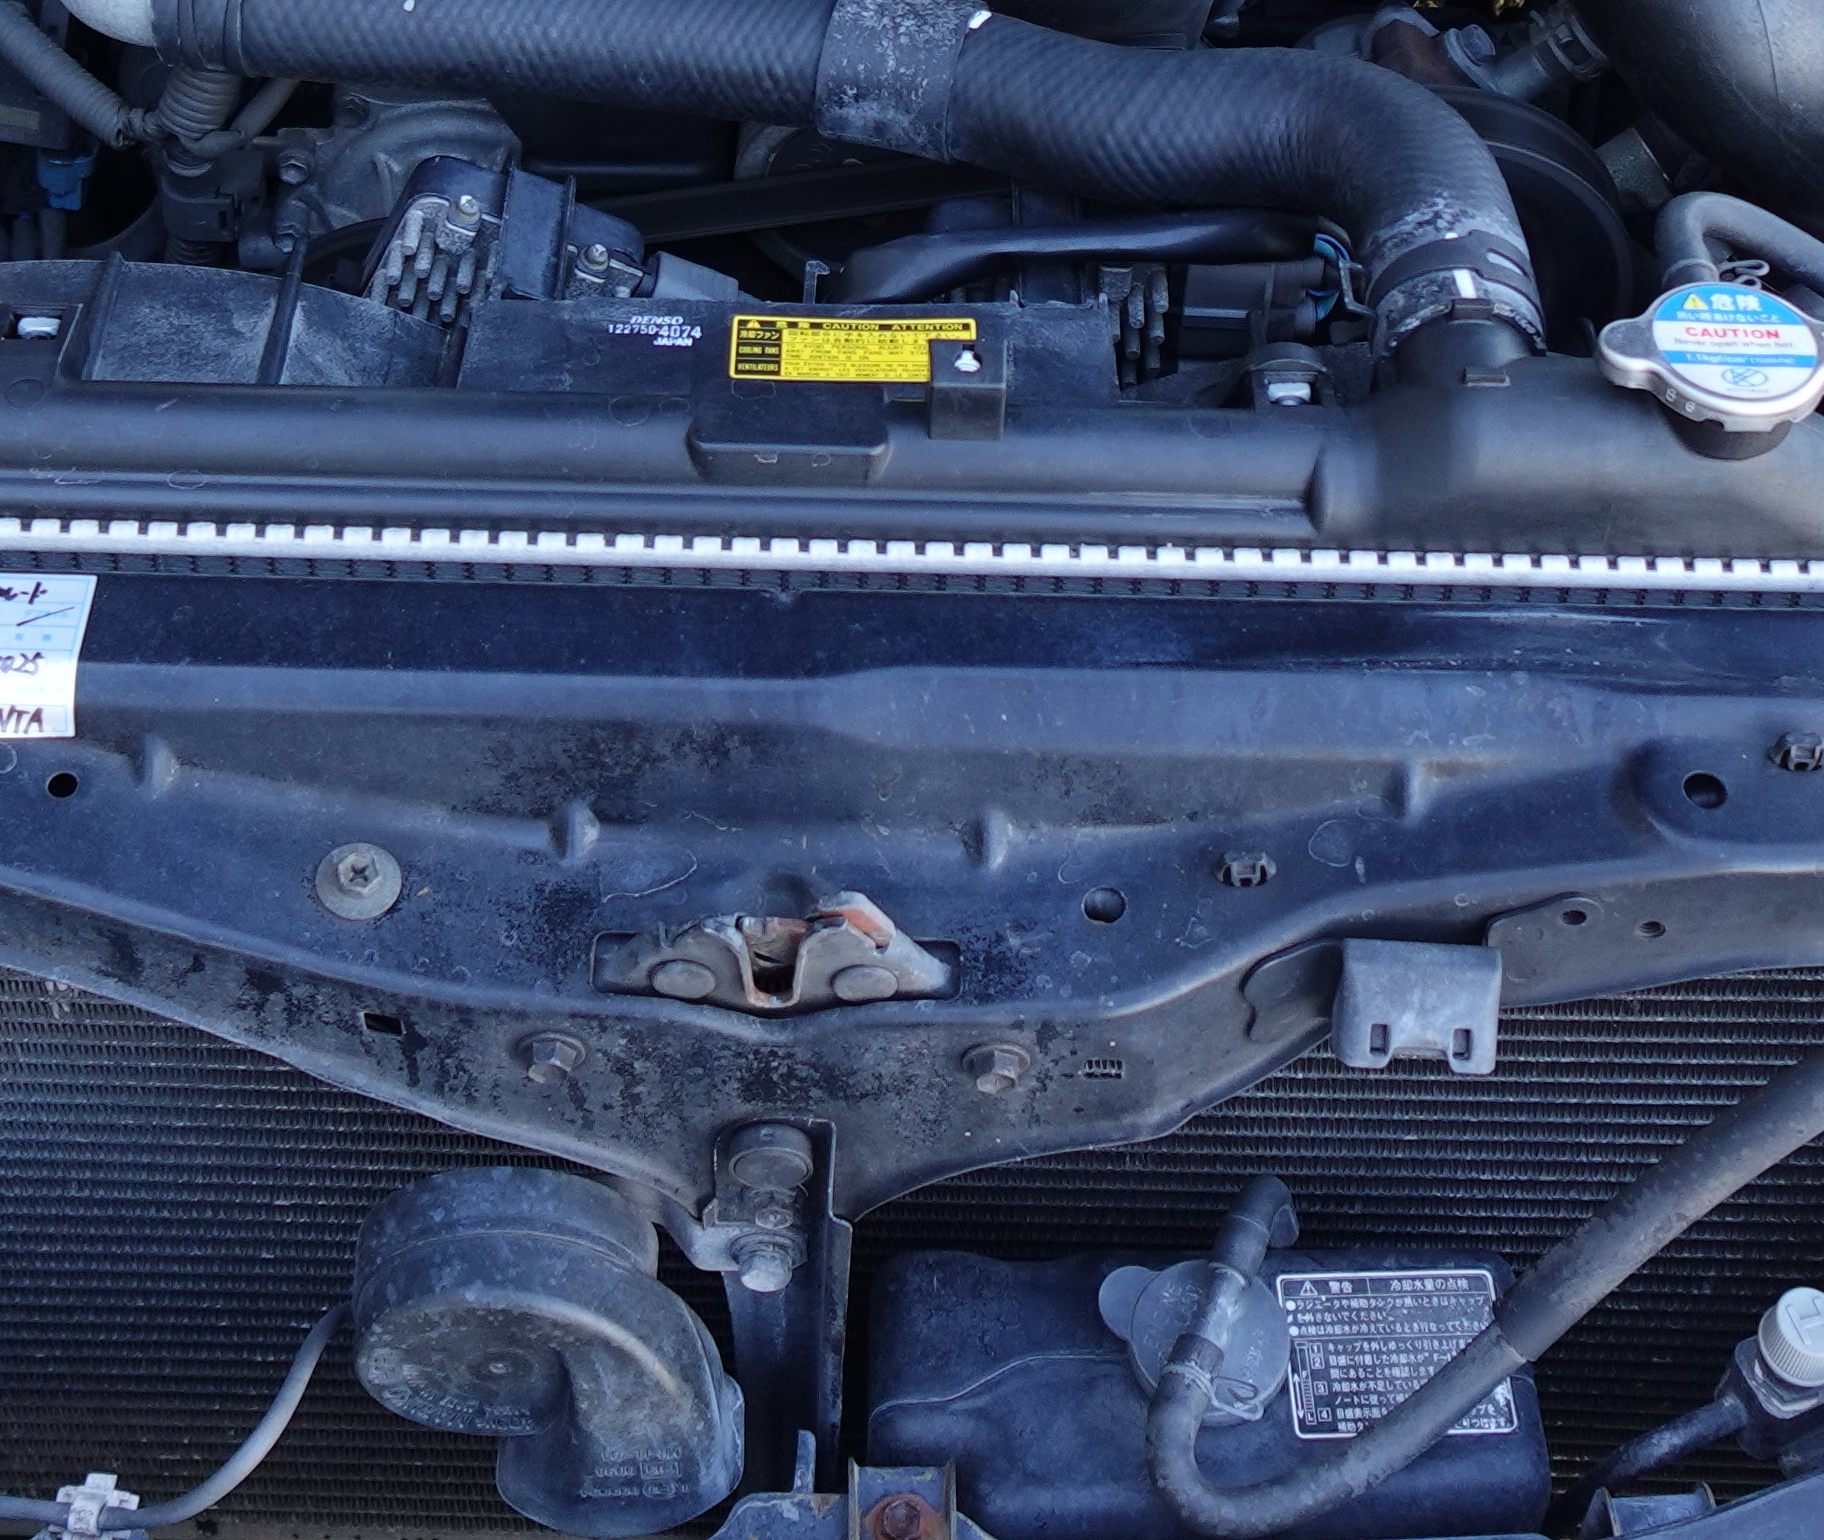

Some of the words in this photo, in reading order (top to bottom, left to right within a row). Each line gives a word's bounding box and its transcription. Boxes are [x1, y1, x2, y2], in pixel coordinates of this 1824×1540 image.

[1710, 294, 1761, 311] 危険
[630, 315, 683, 325] DENSO
[608, 324, 703, 338] 122750-4074
[823, 322, 879, 331] CAUTION
[891, 323, 963, 331] ATTENTION
[1685, 326, 1781, 339] CAUTION
[653, 337, 693, 346] JAPAN
[1710, 341, 1738, 349] open
[1329, 1280, 1353, 1294] 警告
[1389, 1278, 1469, 1291] 冷却水量の点検
